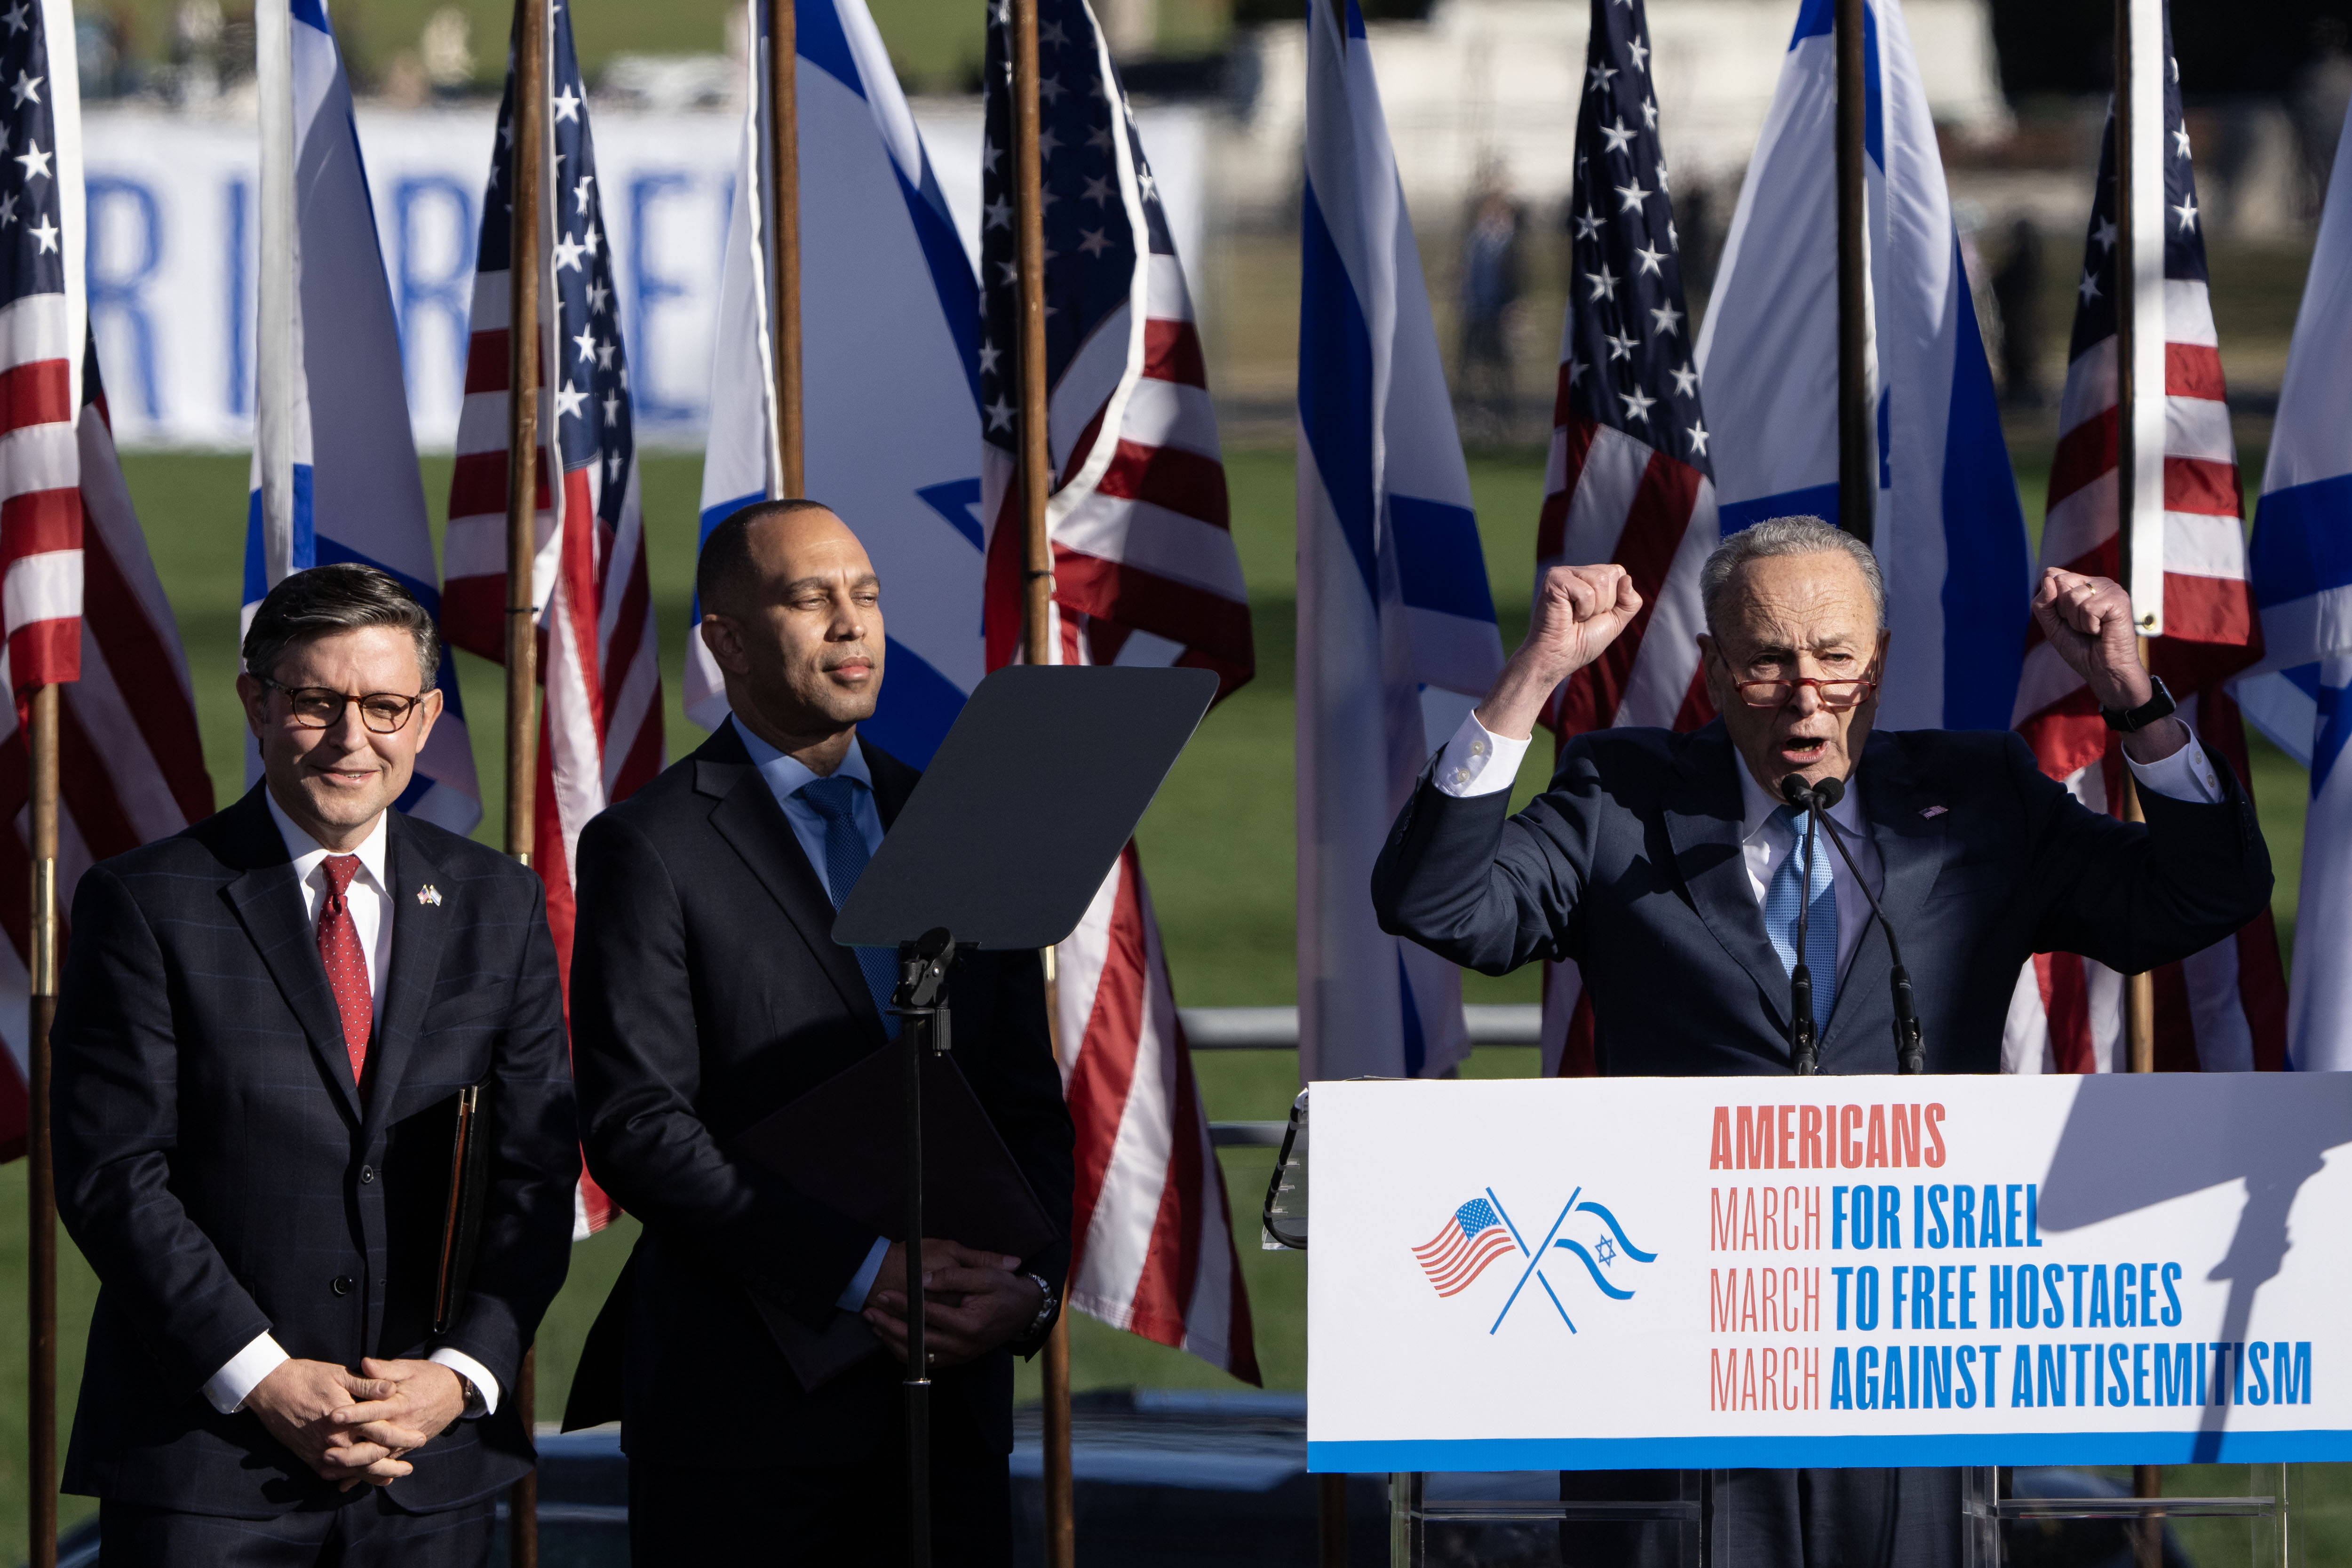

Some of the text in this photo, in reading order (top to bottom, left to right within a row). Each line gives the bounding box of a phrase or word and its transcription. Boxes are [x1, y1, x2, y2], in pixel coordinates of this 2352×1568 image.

[1710, 1103, 1945, 1170] AMERICANS
[1711, 1184, 2042, 1250] MARCH FOR ISRAEL
[1711, 1262, 2182, 1332] MARCH TO FREE HOSTAGES
[1711, 1342, 2311, 1411] MARCH AGAINST ANTISEMITISM
